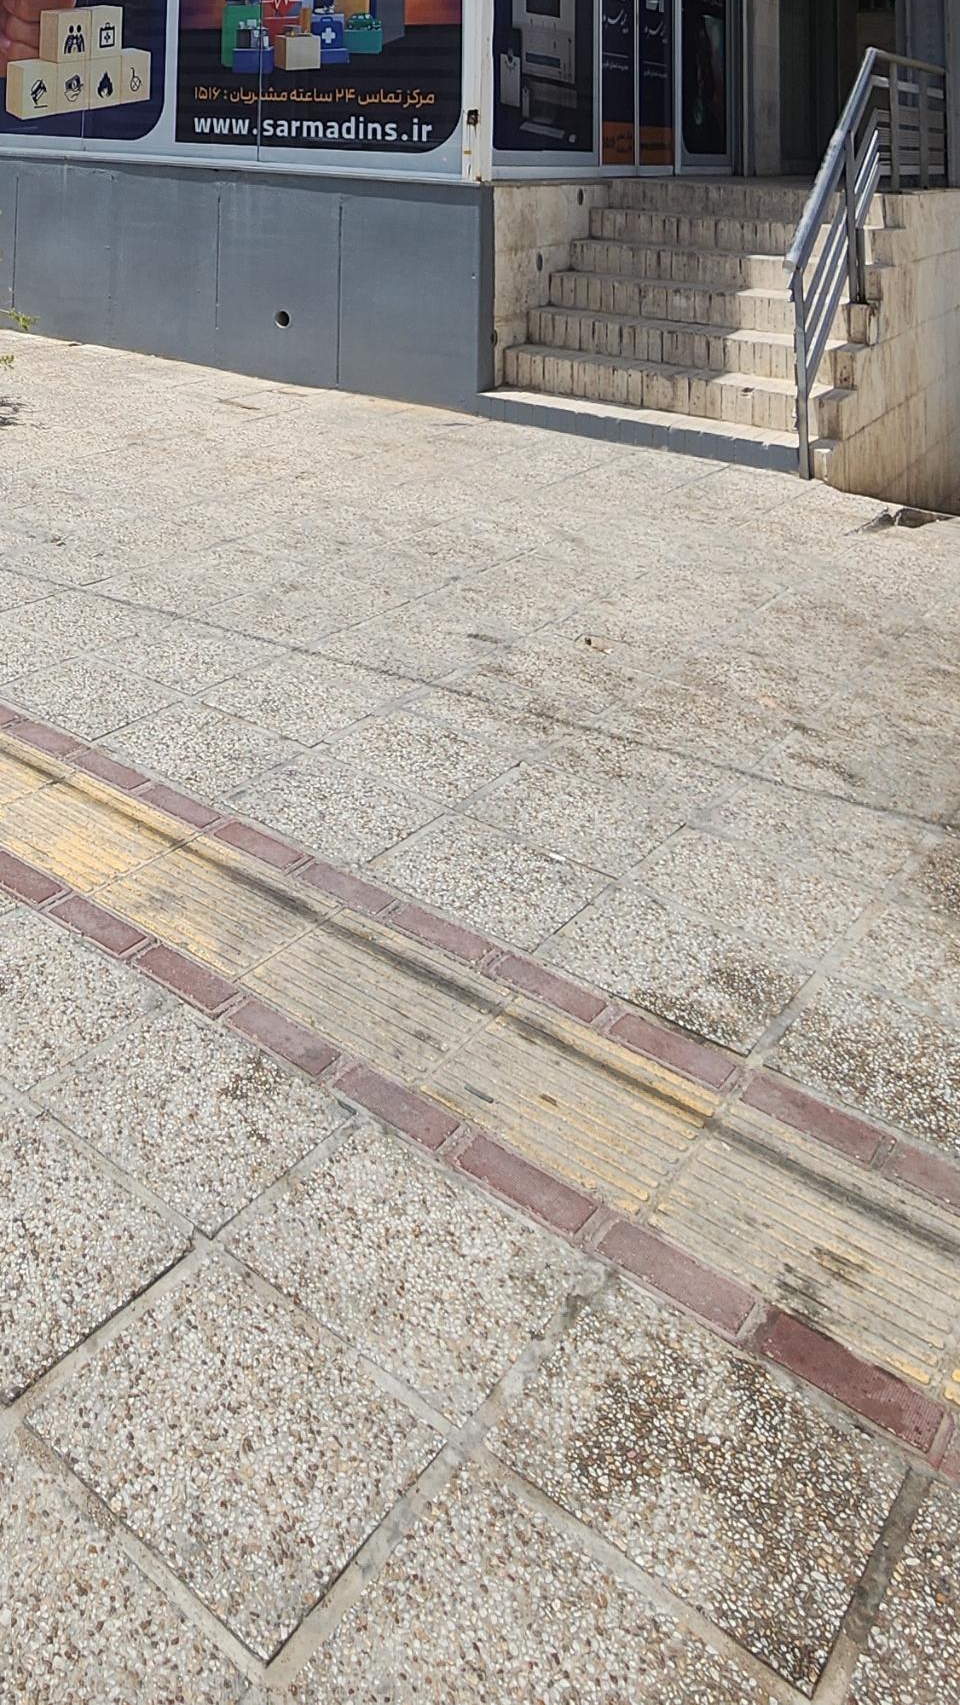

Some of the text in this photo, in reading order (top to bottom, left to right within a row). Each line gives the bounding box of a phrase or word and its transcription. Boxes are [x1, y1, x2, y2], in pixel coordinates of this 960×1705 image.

[194, 86, 221, 99] ۱۵۱۶
[289, 87, 333, 104] ساعته
[335, 88, 356, 103] ۲۴
[358, 87, 402, 105] تماس
[402, 88, 435, 109] مرکز
[193, 115, 433, 142] www.sarmadins.ir
